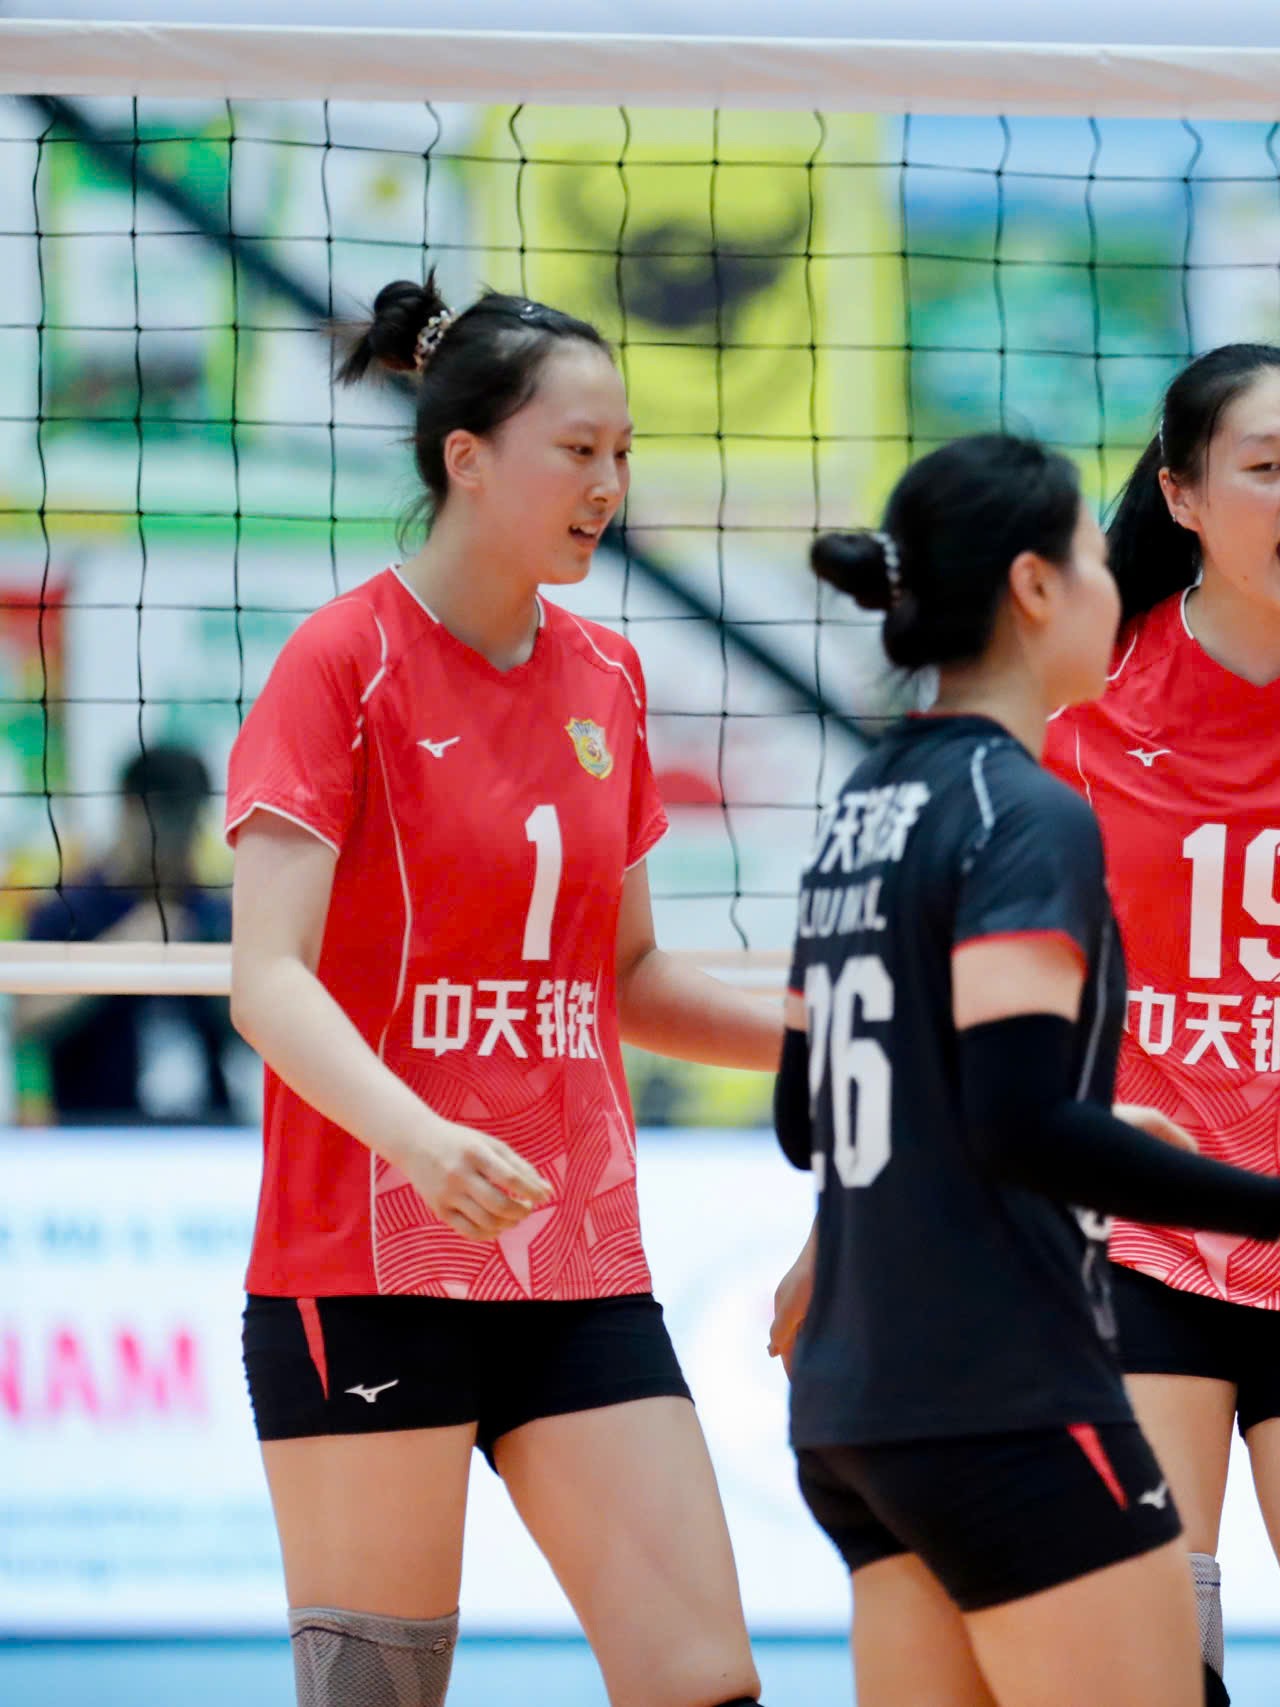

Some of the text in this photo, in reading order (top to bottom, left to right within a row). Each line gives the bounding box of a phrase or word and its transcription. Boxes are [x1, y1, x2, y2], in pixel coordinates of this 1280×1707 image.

[521, 804, 563, 961] 1
[412, 978, 599, 1059] 中天钢铁
